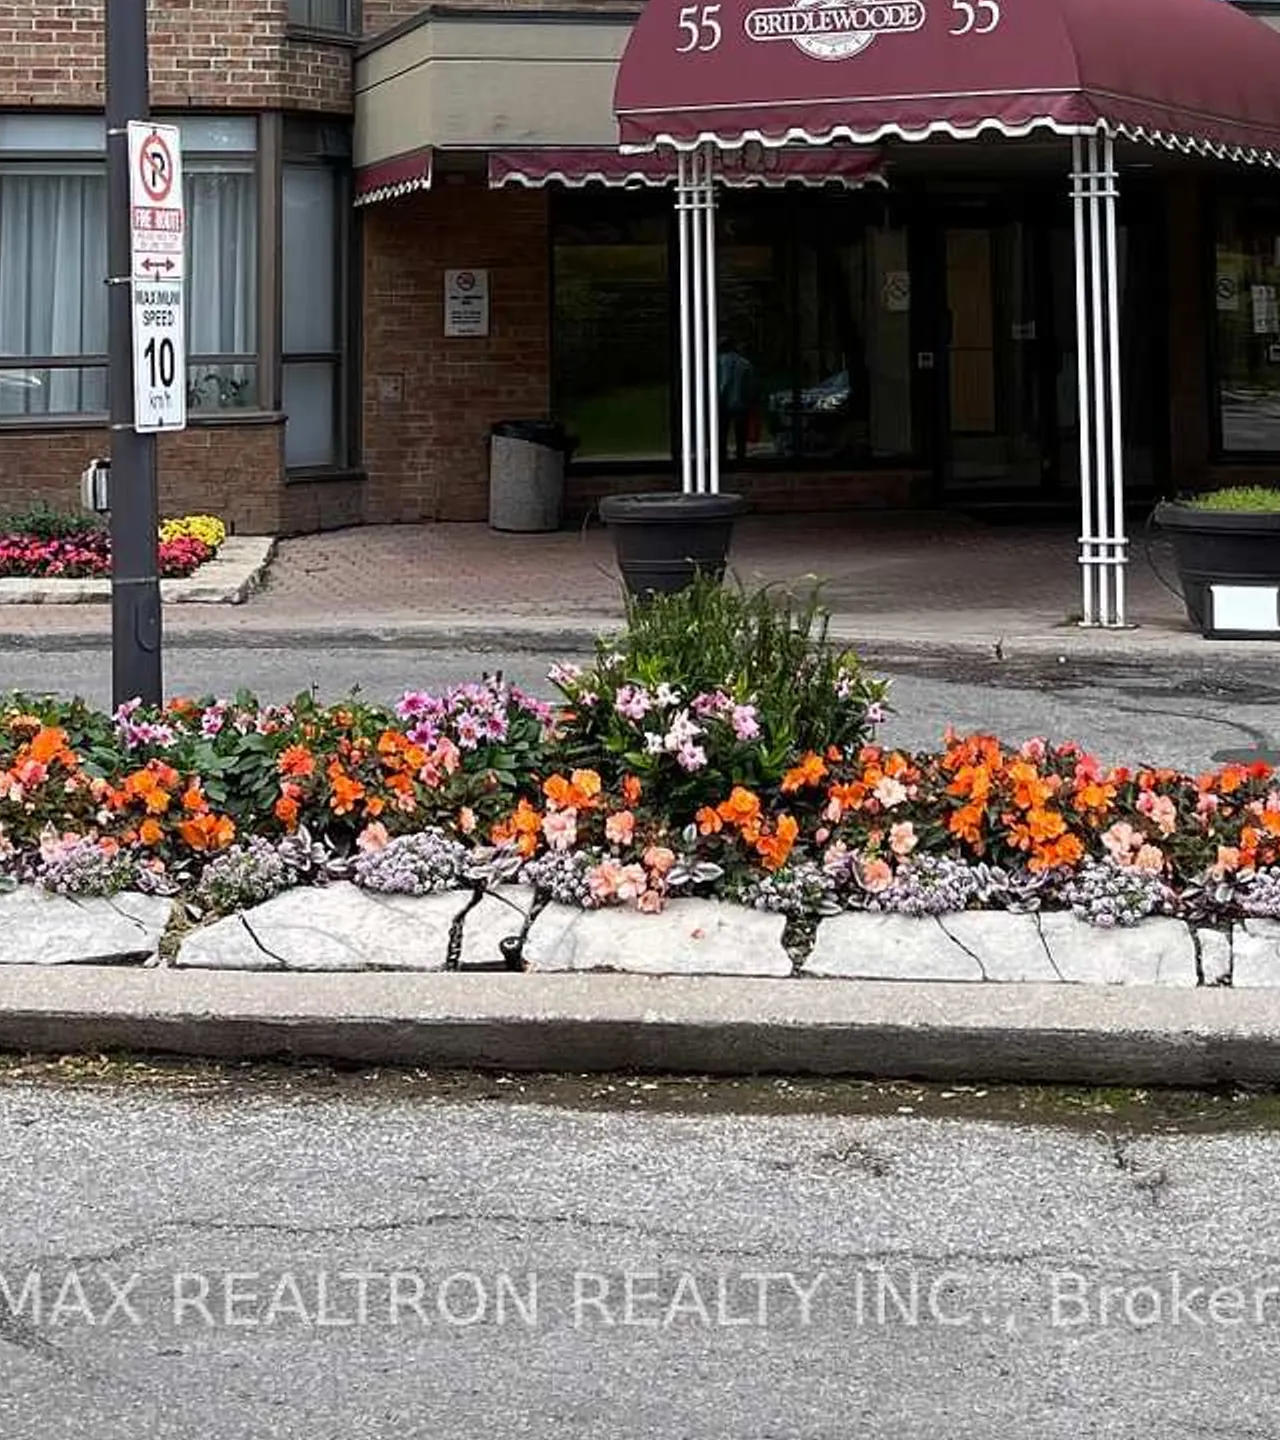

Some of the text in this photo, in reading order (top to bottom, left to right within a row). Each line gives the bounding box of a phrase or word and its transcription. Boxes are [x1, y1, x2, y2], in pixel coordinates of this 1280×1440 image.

[676, 4, 721, 52] 55
[753, 5, 918, 35] BRIDLEWOODE
[135, 290, 181, 305] MAXIMUM
[143, 310, 176, 327] SPEED
[144, 337, 175, 388] 10
